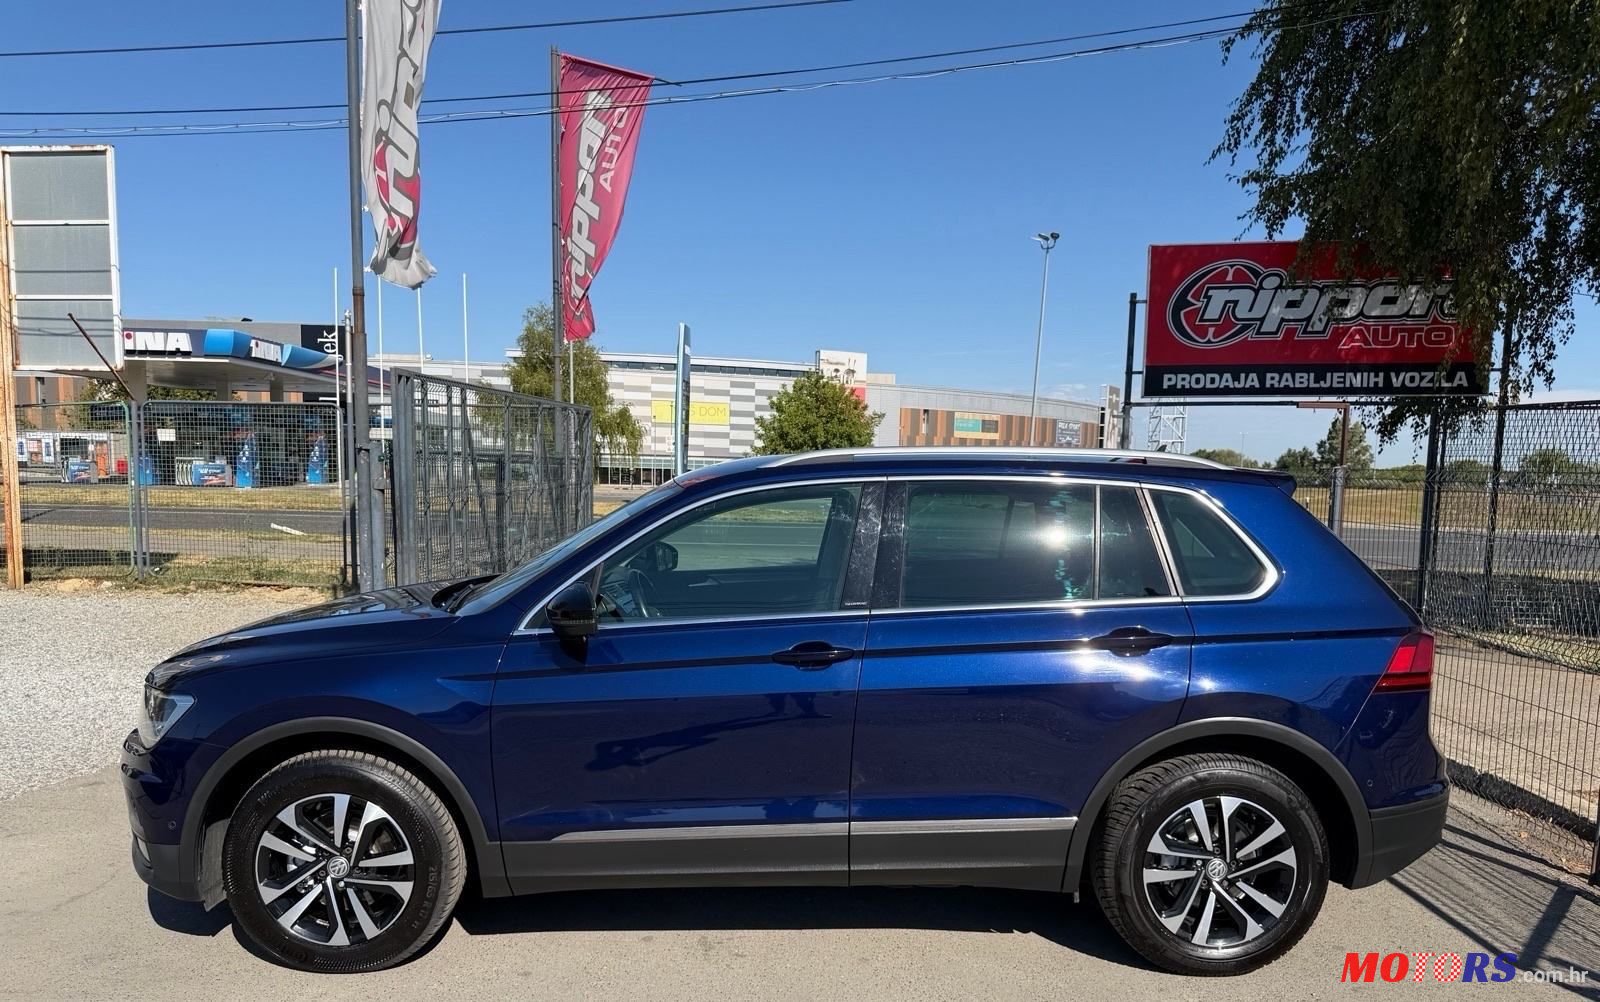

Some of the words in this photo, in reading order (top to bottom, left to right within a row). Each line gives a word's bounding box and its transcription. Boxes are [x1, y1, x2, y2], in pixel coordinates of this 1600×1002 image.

[599, 107, 629, 193] AUTO
[124, 331, 193, 352] INA
[1339, 324, 1455, 349] AUTO
[1162, 373, 1260, 389] PRODAJA
[1265, 371, 1384, 388] RABLJENIH
[699, 406, 726, 417] DOM
